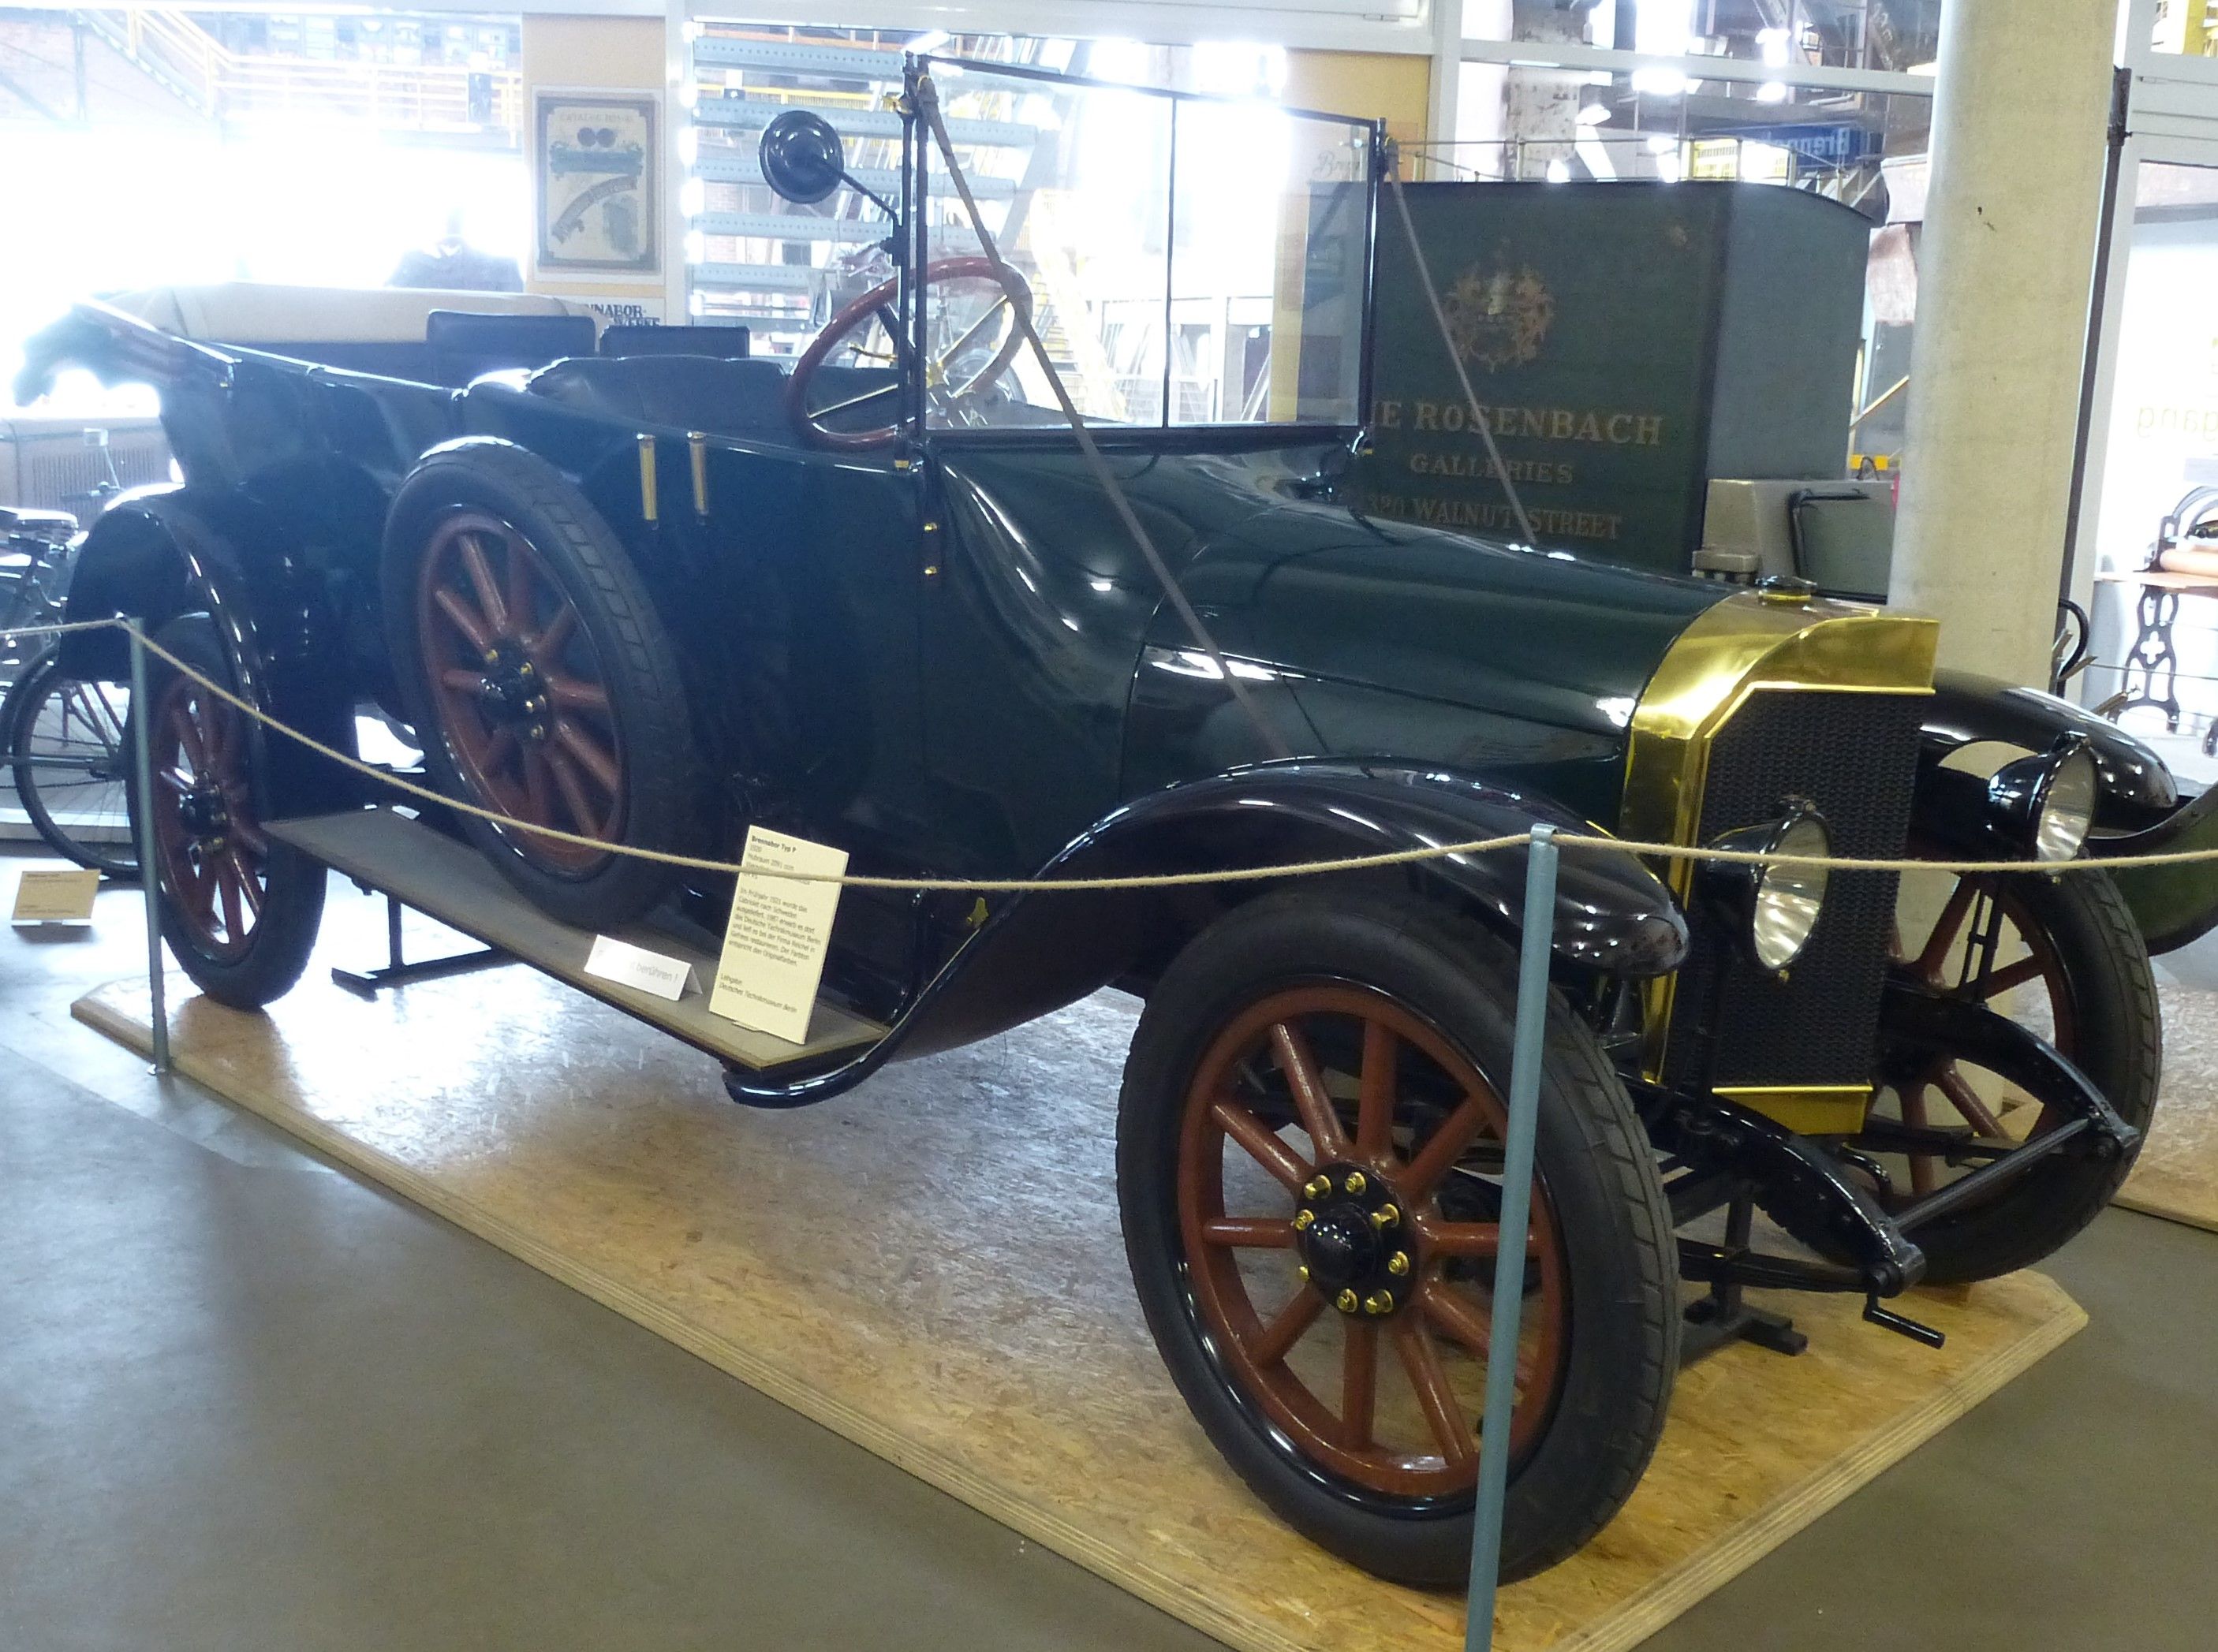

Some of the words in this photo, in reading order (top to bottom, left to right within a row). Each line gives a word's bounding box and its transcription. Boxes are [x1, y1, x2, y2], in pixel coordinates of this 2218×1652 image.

[1413, 401, 1664, 445] ROSENBACH
[1410, 453, 1574, 484] GALLERIES
[1413, 498, 1514, 529] WALNUT
[1526, 506, 1622, 541] STREET
[751, 835, 780, 848] Brennabor
